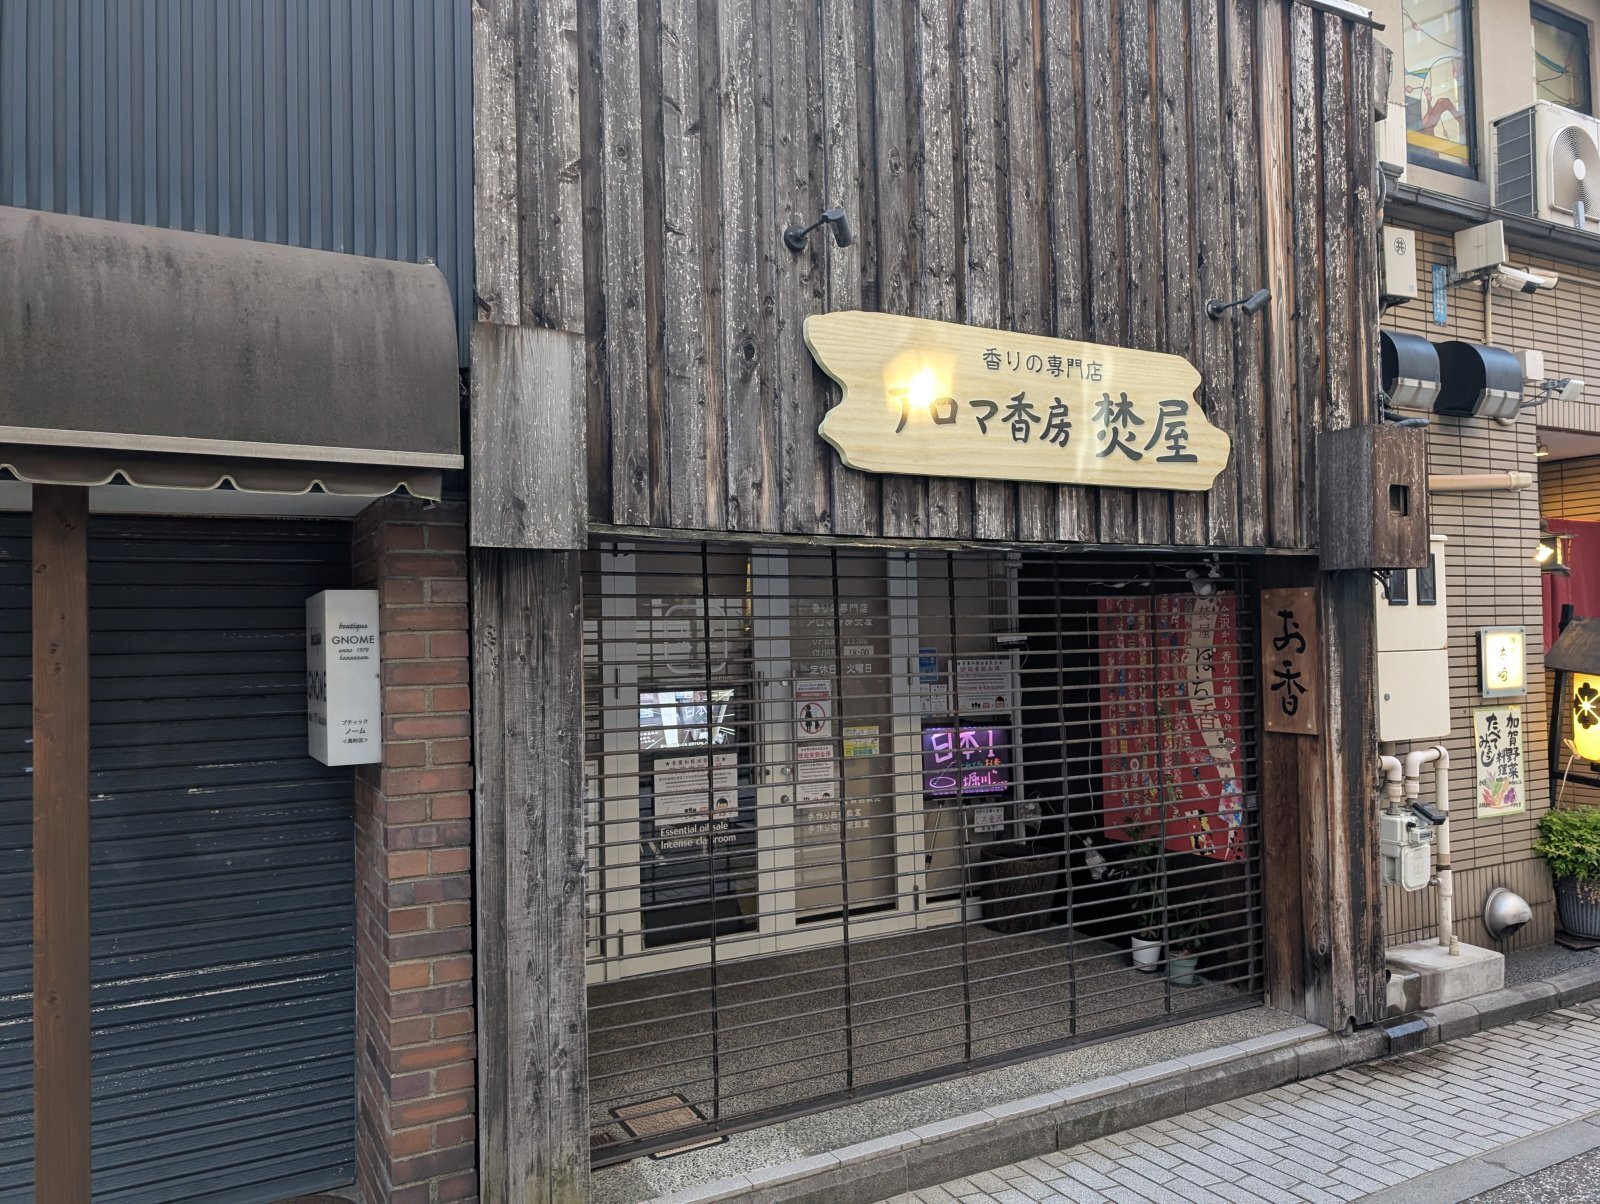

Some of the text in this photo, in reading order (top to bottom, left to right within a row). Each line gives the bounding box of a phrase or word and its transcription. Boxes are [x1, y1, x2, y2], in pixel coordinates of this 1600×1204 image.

[982, 347, 1103, 382] 香りの専門店
[1091, 391, 1198, 464] 焚屋
[331, 635, 375, 645] GNOME
[847, 663, 872, 675] 火曜日
[1270, 609, 1309, 717] お香
[1505, 711, 1521, 779] 加賀野菜
[660, 823, 697, 837] Essential
[712, 821, 729, 831] sale
[661, 834, 737, 850] Incense claroom
